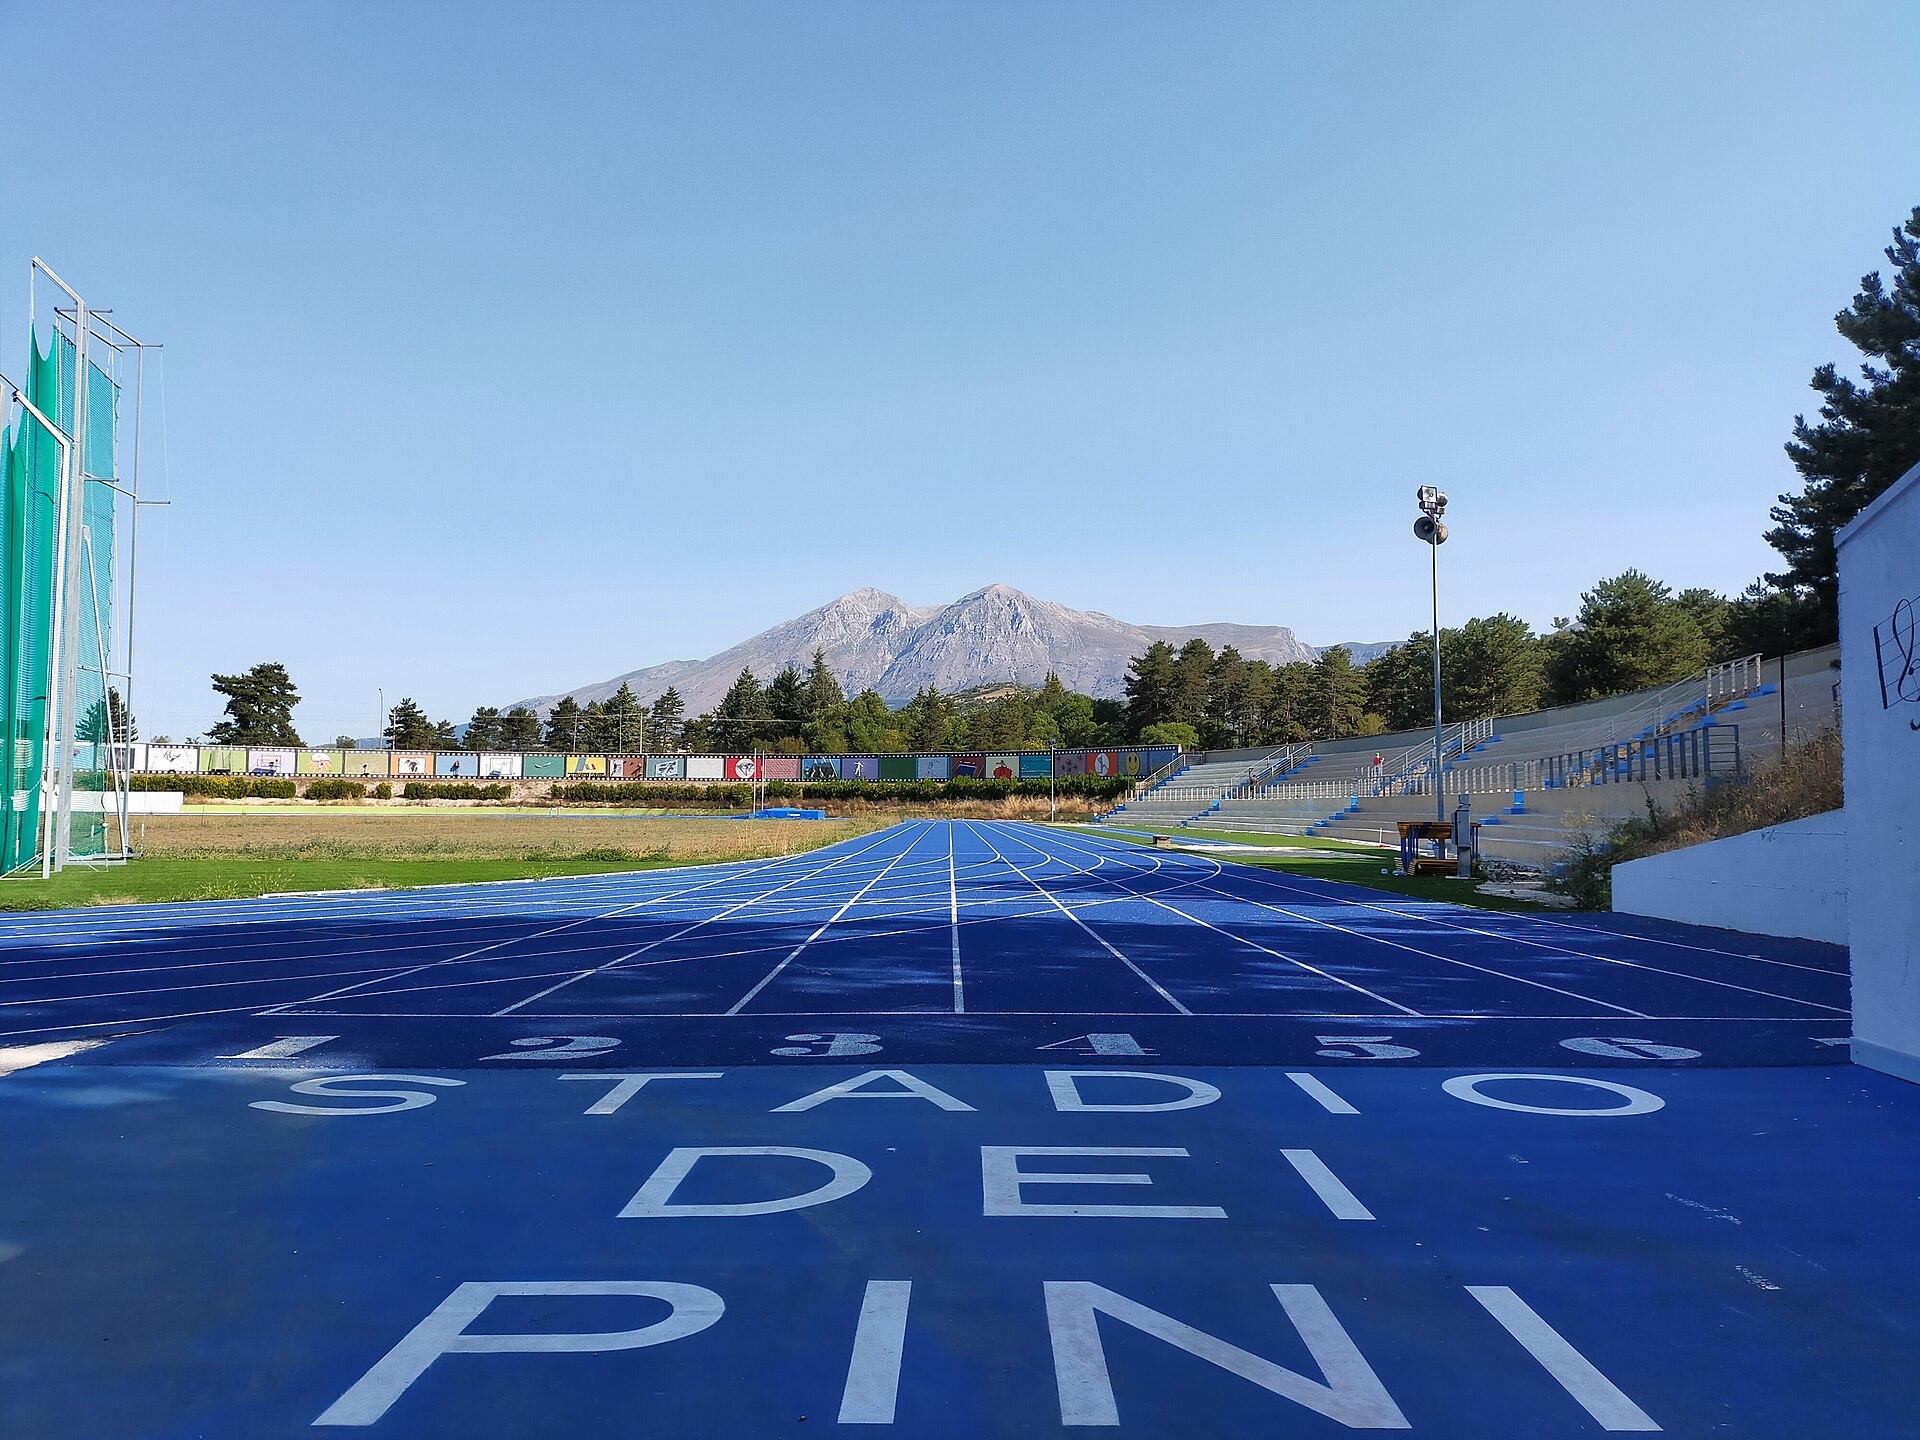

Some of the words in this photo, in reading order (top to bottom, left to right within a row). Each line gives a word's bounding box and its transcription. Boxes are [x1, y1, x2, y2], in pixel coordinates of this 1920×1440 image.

[214, 1035, 342, 1061] 1
[478, 1035, 623, 1061] 2
[769, 1032, 884, 1058] 3
[1035, 1032, 1162, 1057] 4
[1313, 1035, 1422, 1060] 5
[1558, 1036, 1703, 1060] 6
[247, 1069, 1667, 1117] STADIO
[615, 1145, 1376, 1221] DEI
[311, 1279, 1664, 1432] PINI
